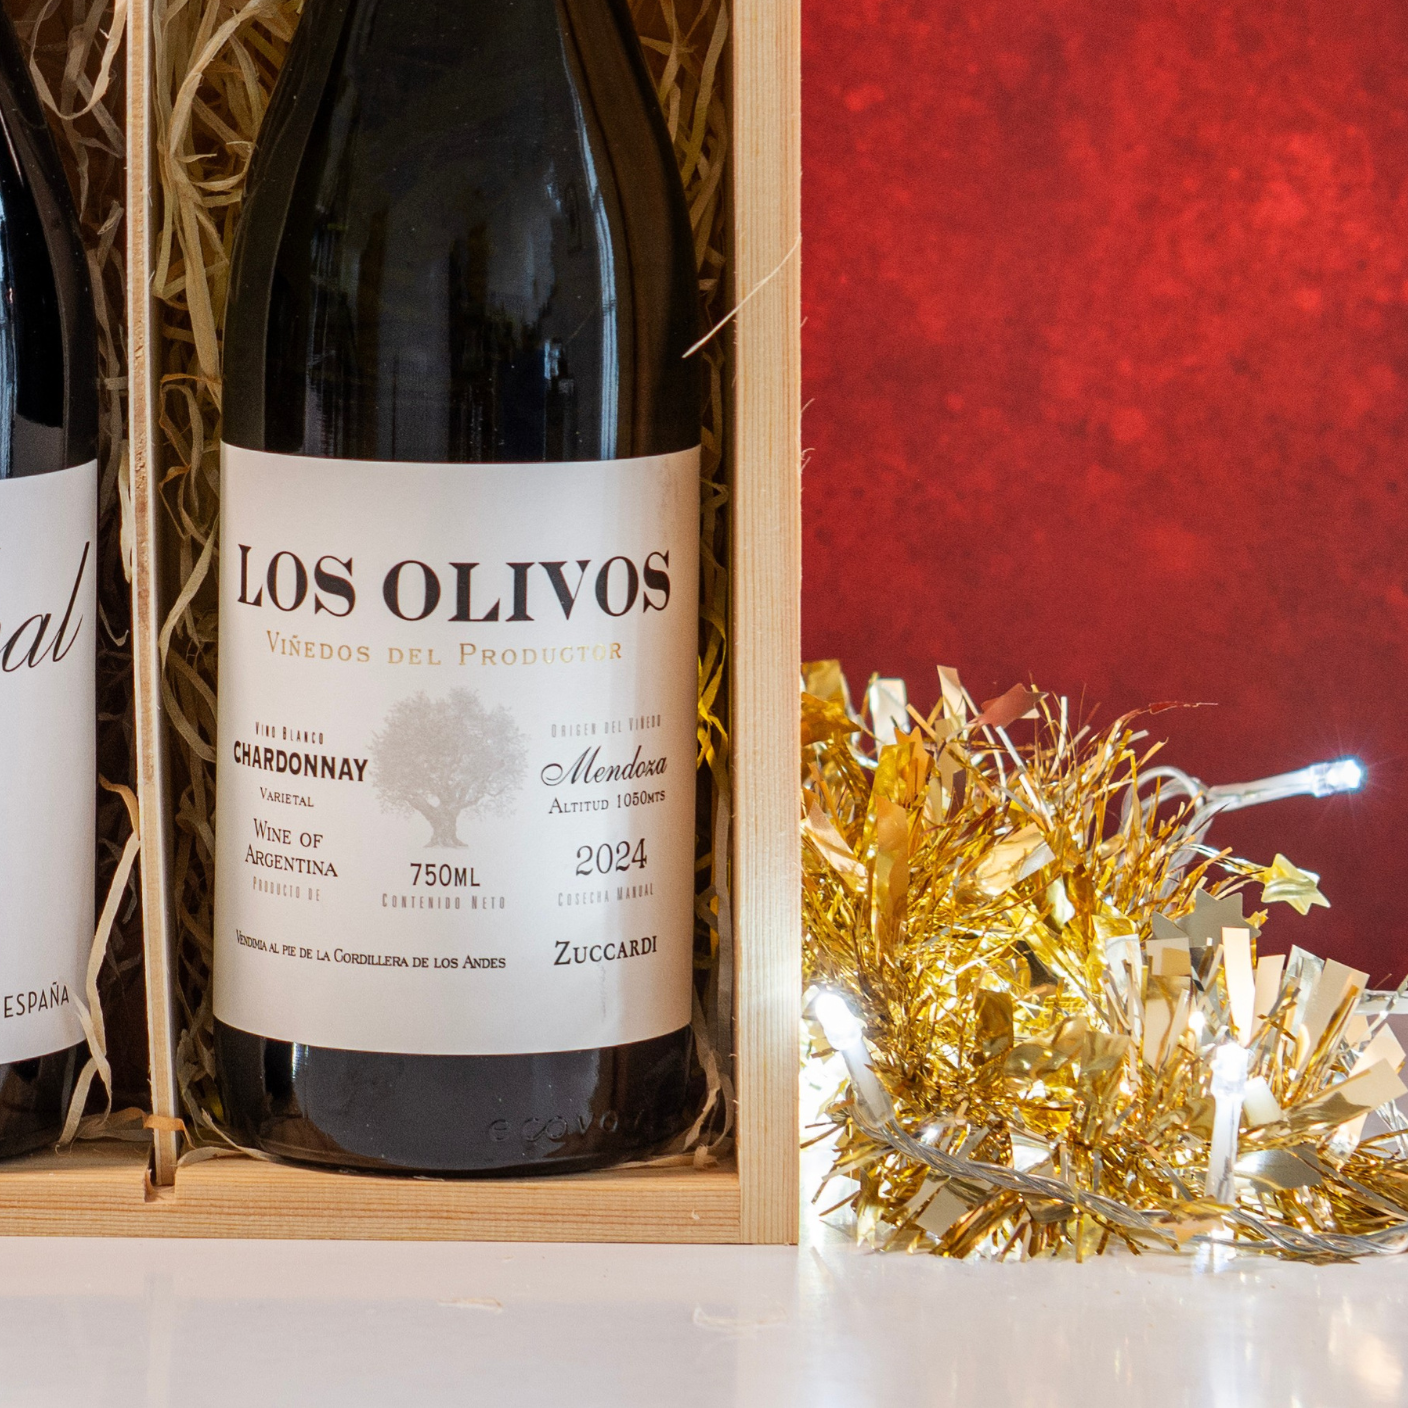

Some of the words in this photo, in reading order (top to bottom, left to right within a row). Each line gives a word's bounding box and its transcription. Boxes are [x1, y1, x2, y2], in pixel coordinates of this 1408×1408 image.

[236, 543, 356, 617] LOS
[382, 550, 671, 623] OLIVOS
[387, 646, 441, 666] DEL
[458, 642, 623, 666] PRODUCTOR
[282, 726, 324, 745] BLANCO
[233, 740, 369, 782] CHARDONNAY
[540, 745, 667, 786] Mendoza
[259, 786, 315, 808] VARIETAL
[548, 796, 609, 814] ALTITUD
[617, 790, 666, 809] 1050MTS
[253, 817, 292, 845] WINE
[299, 832, 323, 849] OF
[244, 844, 339, 878] ARGENTINA
[575, 838, 648, 876] 2024
[252, 876, 300, 899] PRODUCTO
[308, 888, 320, 902] DE
[410, 862, 481, 887] 750ML
[381, 893, 461, 910] CONTENIDO
[471, 895, 506, 910] NETO
[558, 890, 610, 907] COSECHA
[616, 883, 654, 901] MANUAL
[235, 928, 267, 952] VENDIMIA
[268, 942, 280, 954] AL
[282, 944, 296, 957] PIE
[299, 947, 313, 960] DE
[316, 950, 331, 962] LA
[333, 948, 409, 968] CORDILLERA
[412, 956, 429, 969] DE
[433, 957, 459, 969] LOS
[462, 955, 507, 969] ANDES
[553, 935, 658, 966] ZUCCARDI
[3, 981, 70, 1019] ESPAÑA
